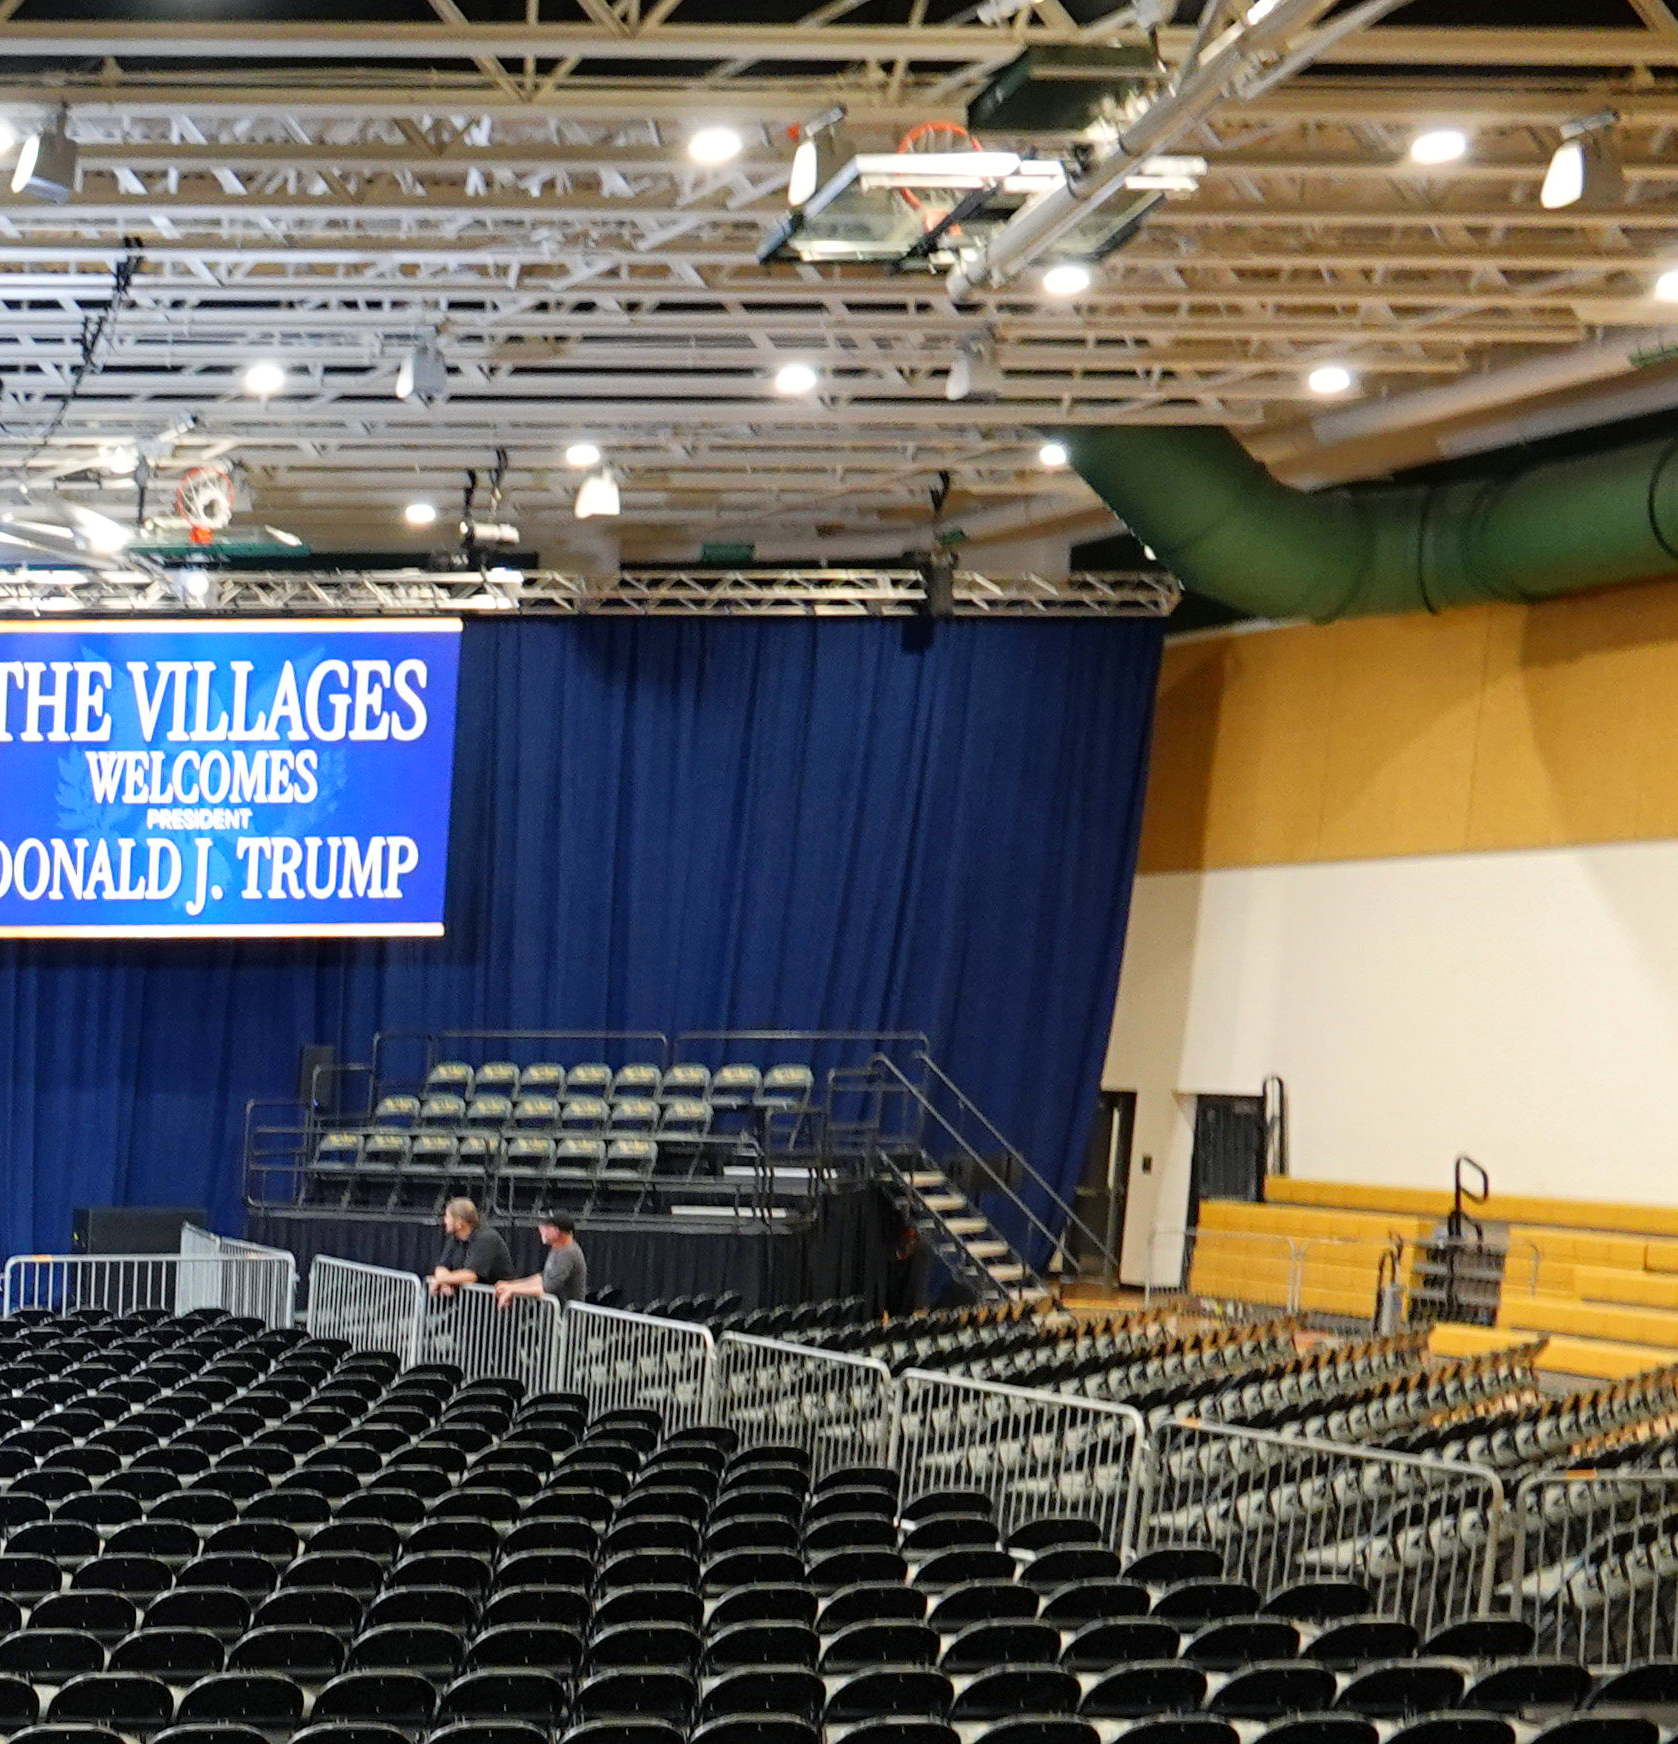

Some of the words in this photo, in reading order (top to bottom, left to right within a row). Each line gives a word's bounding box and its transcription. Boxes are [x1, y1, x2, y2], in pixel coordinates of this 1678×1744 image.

[127, 659, 427, 741] VILLAGES
[85, 750, 317, 804] WELCOMES
[147, 808, 252, 830] PRESIDENT
[187, 838, 223, 915] J.
[237, 836, 418, 899] TRUMP
